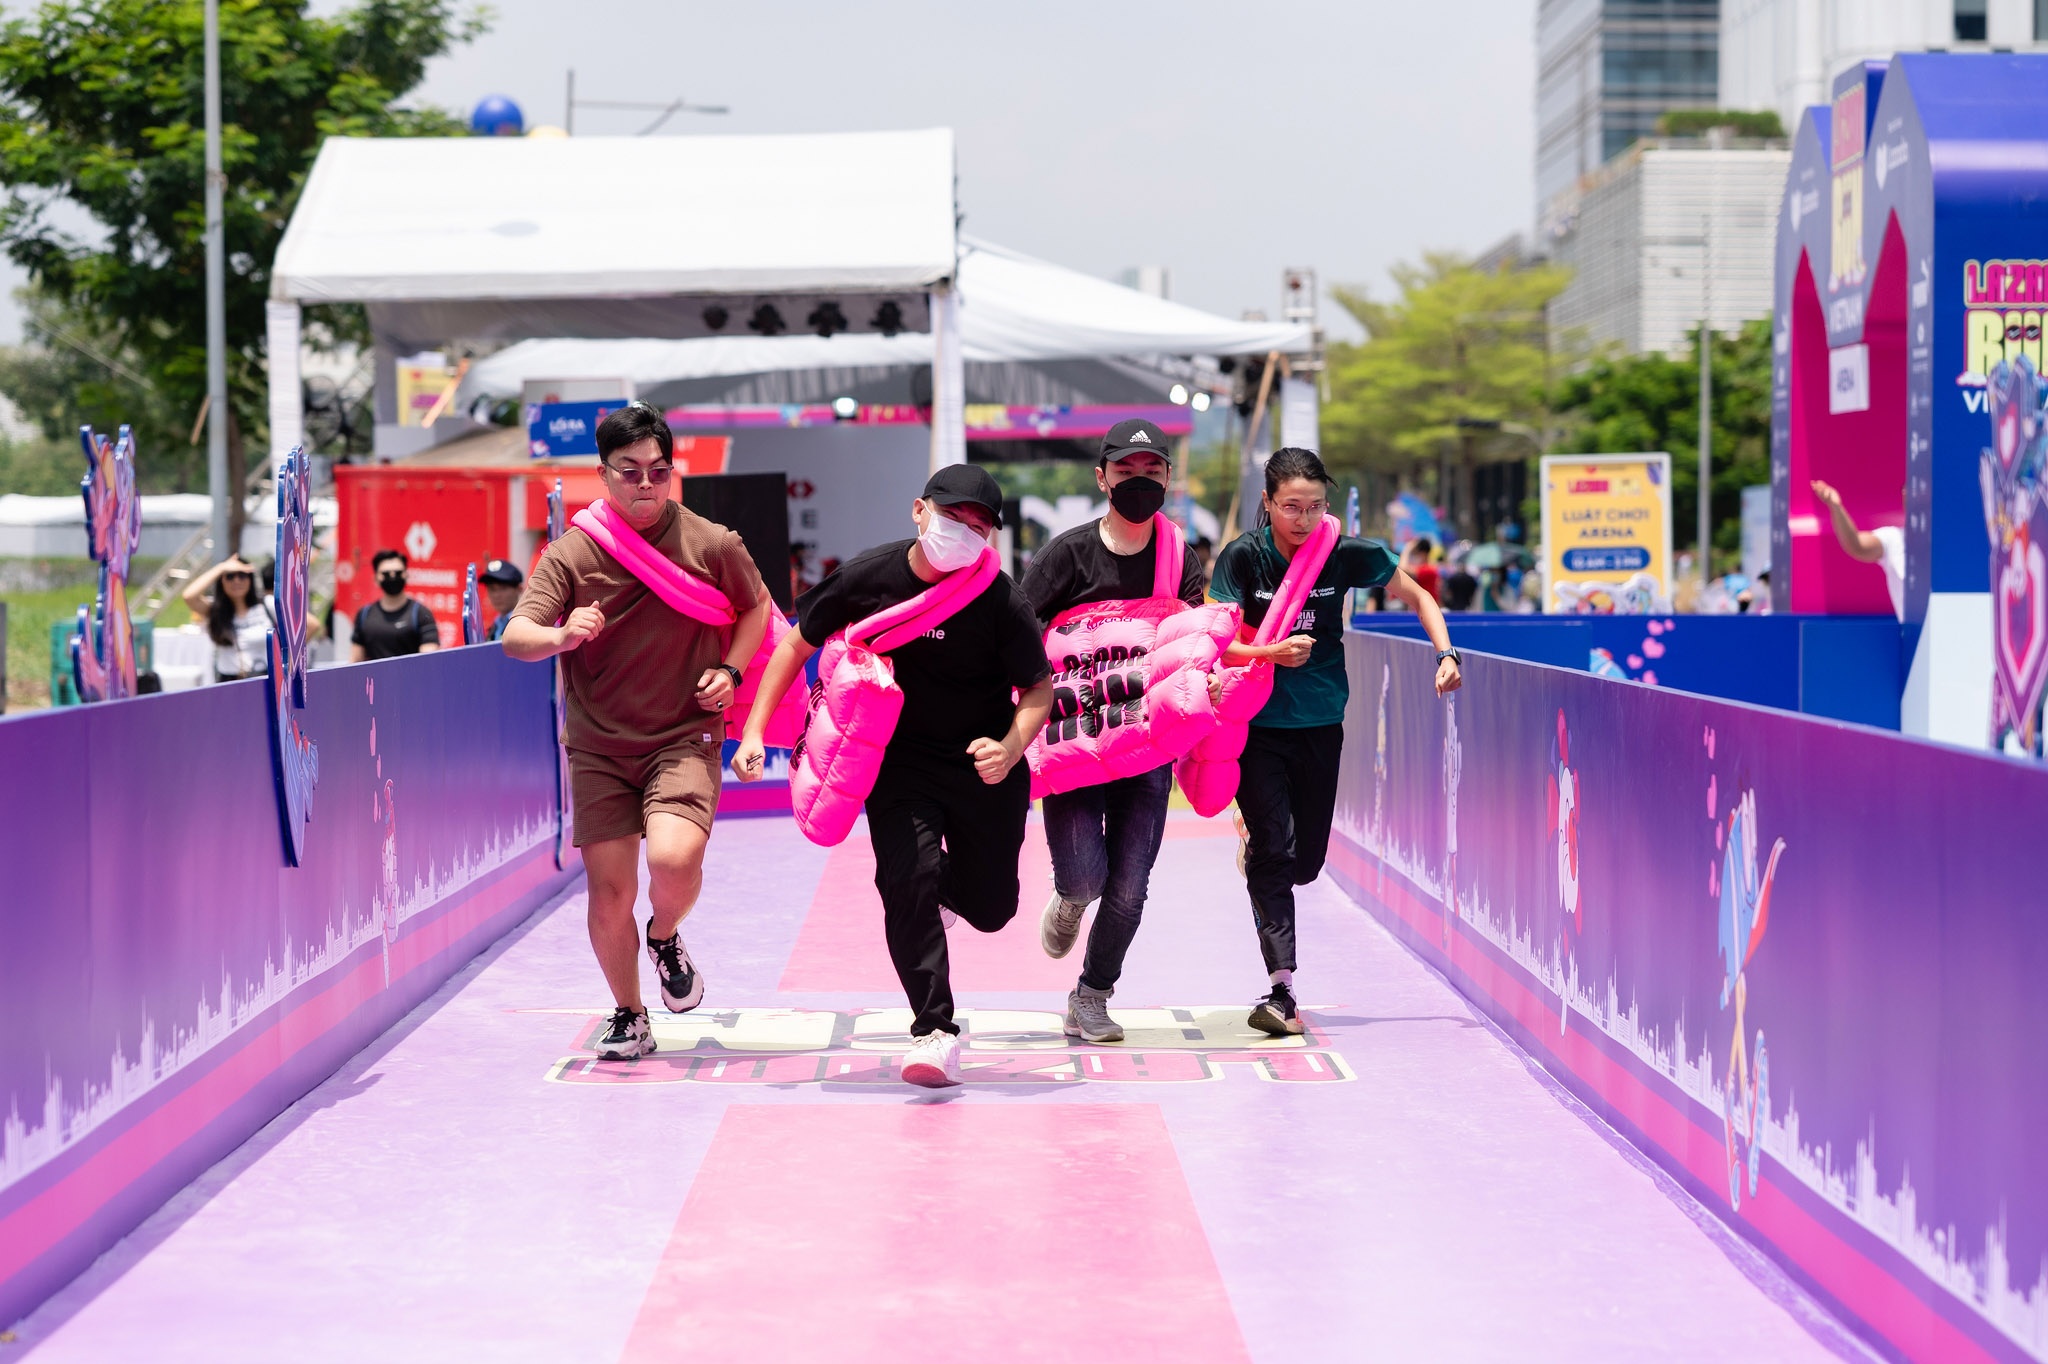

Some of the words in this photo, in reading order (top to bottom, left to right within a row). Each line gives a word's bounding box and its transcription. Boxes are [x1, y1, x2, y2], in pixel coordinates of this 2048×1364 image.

[1579, 527, 1635, 539] ARENA
[1298, 611, 1316, 620] RIAL
[1046, 671, 1145, 745] RUN
